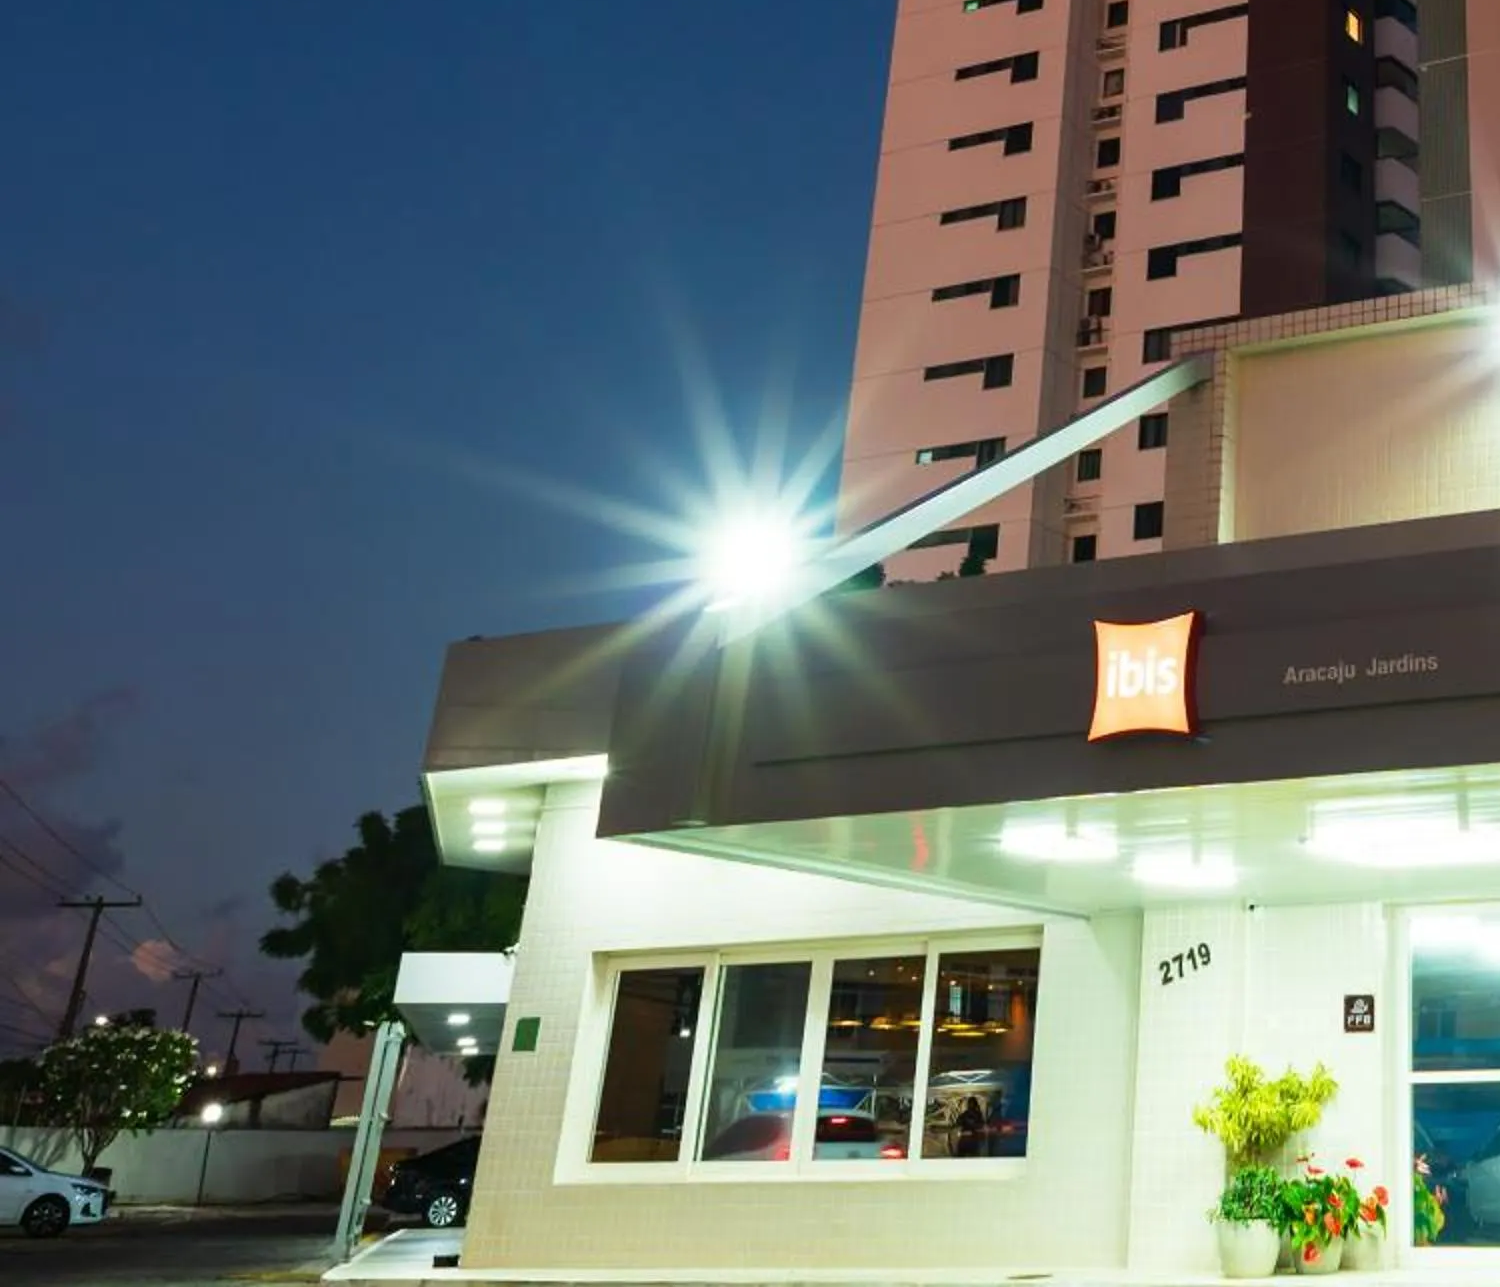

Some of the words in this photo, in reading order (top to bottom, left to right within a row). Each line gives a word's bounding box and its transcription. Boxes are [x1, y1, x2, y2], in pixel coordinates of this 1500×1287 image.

[1106, 646, 1178, 698] ibis
[1283, 662, 1356, 685] Aracaju
[1366, 653, 1438, 677] Jardins
[1158, 942, 1211, 985] 2719
